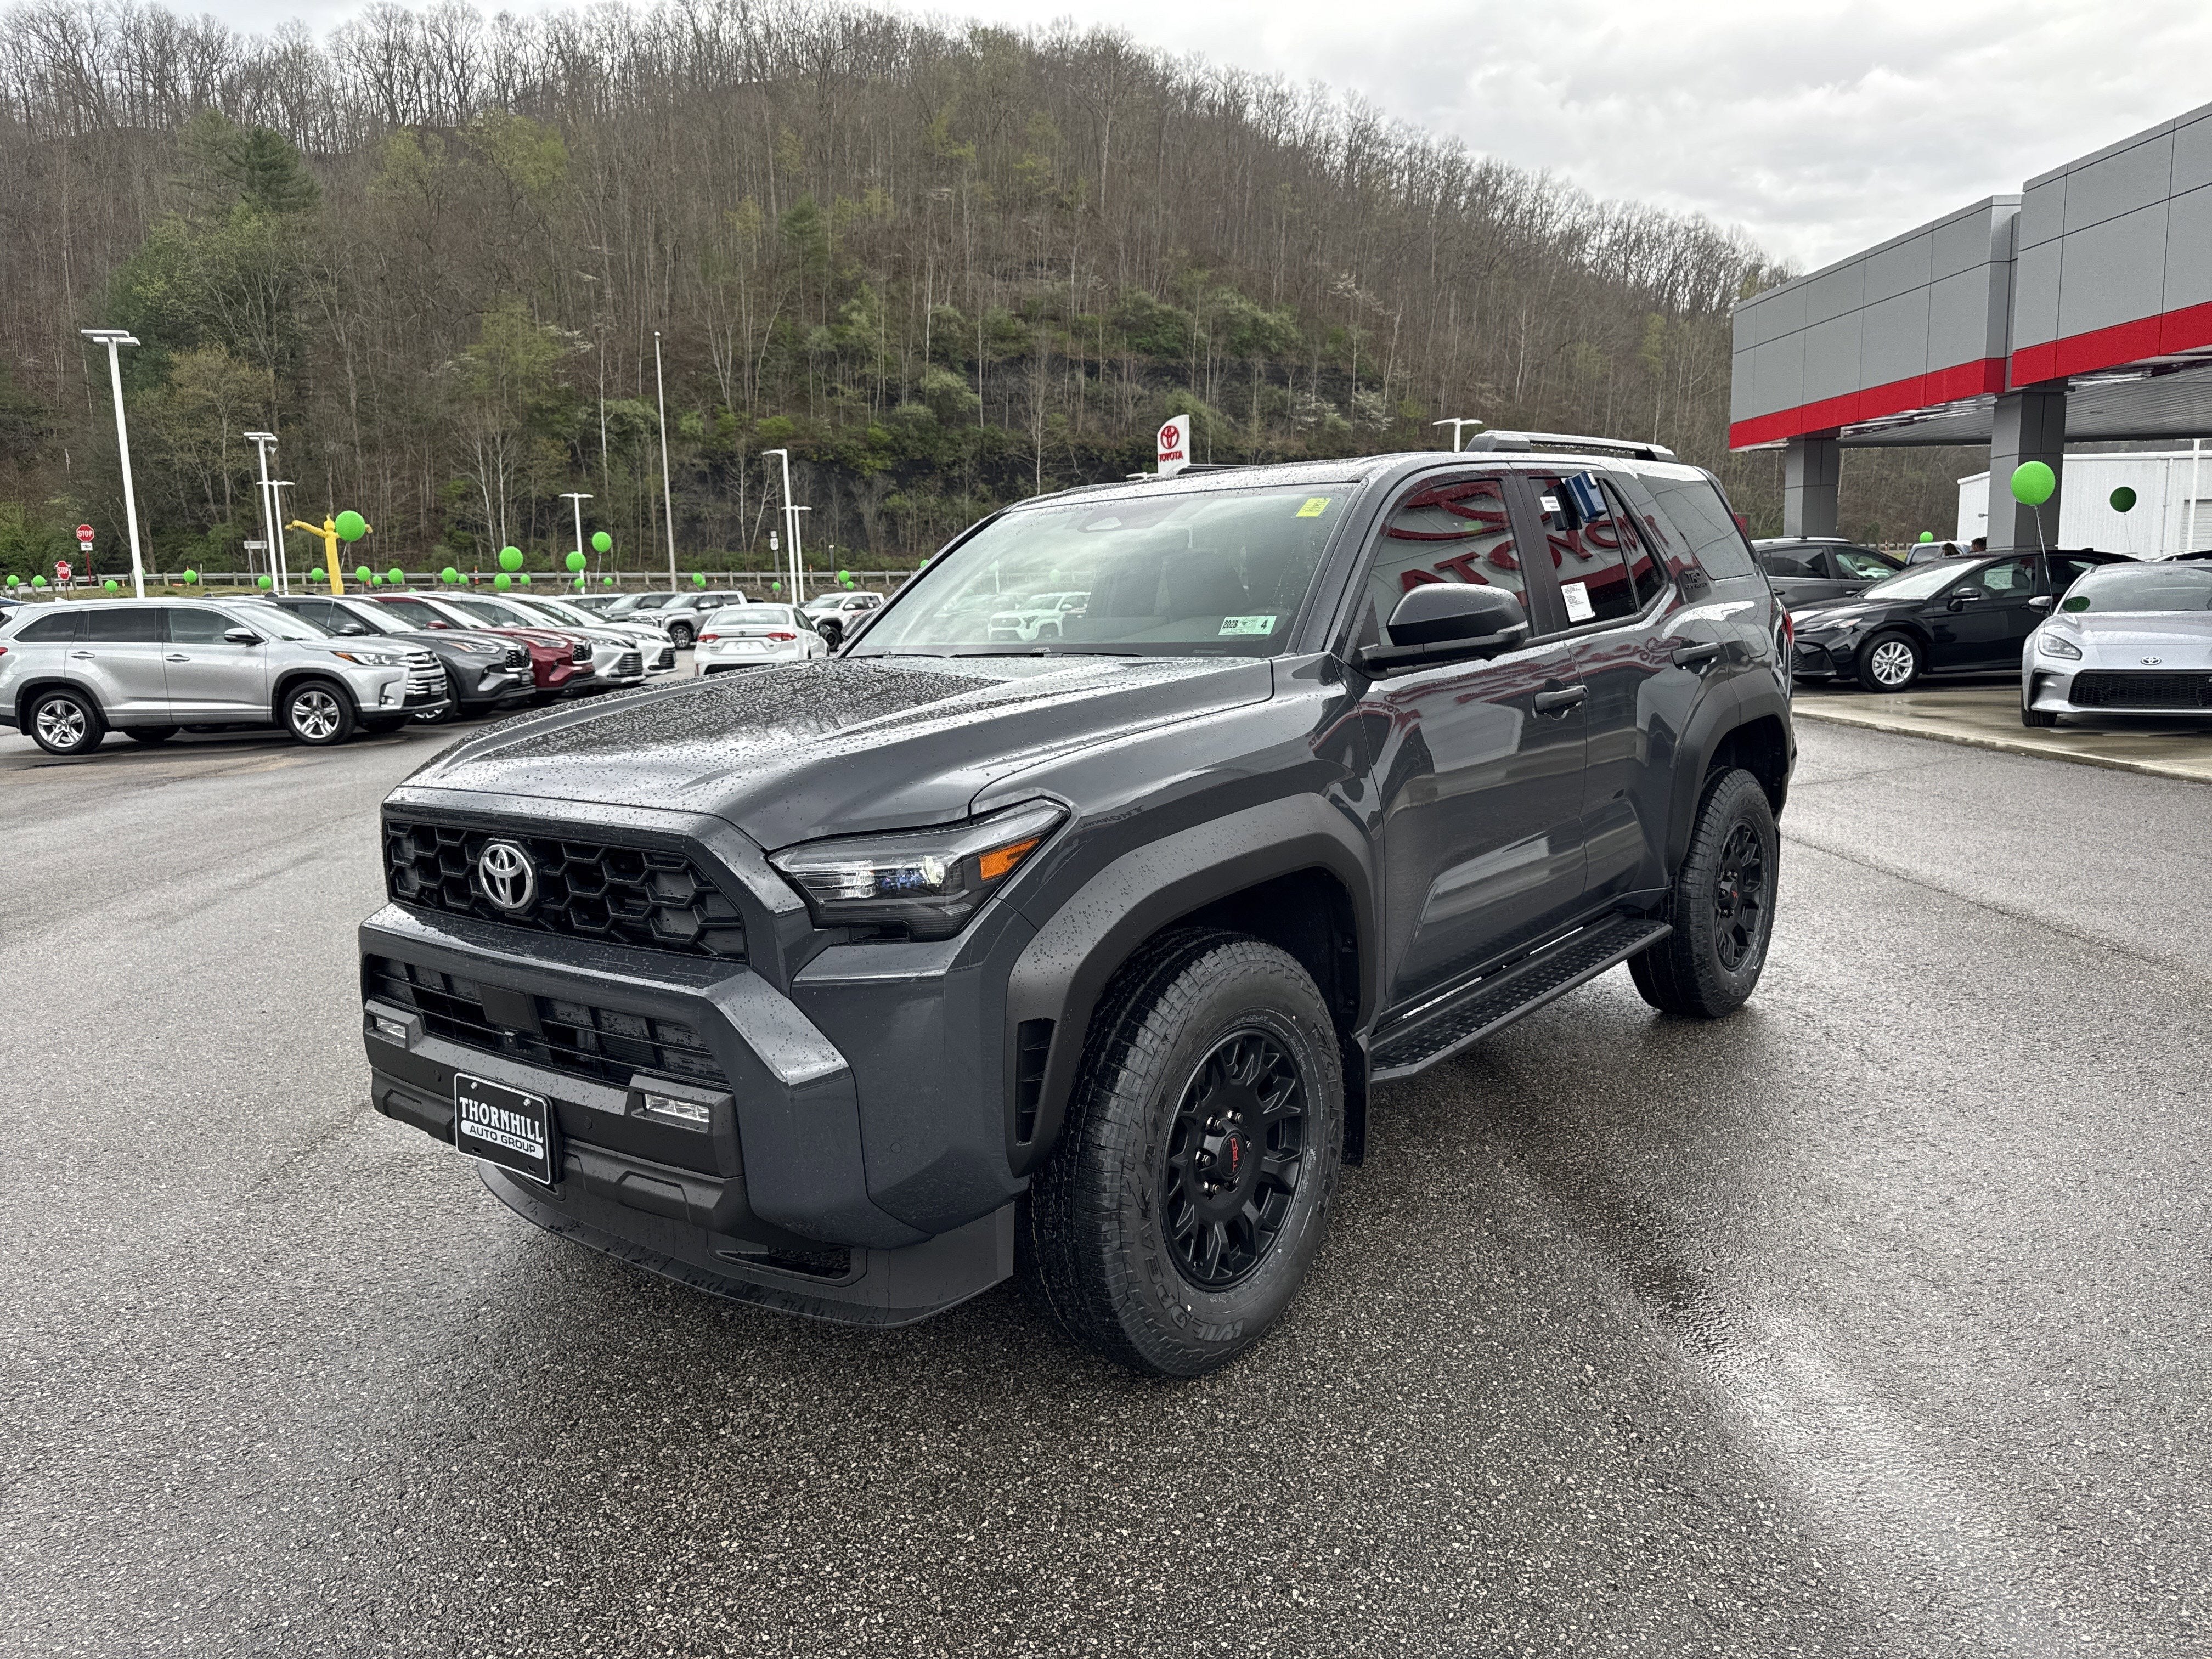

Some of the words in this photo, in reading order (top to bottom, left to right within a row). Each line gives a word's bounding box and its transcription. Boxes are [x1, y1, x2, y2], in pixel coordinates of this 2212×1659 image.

[1158, 450, 1183, 462] TOYOTA
[1684, 569, 1701, 583] TRD
[1222, 620, 1239, 629] 2028
[1261, 619, 1268, 629] 4
[459, 1097, 544, 1144] THORNHILL
[1310, 1022, 1344, 1219] FALKEN
[470, 1125, 498, 1141] AUTO
[501, 1135, 535, 1153] GROUP
[1229, 1137, 1239, 1173] TRD
[1138, 1184, 1244, 1342] WILDPEAK
